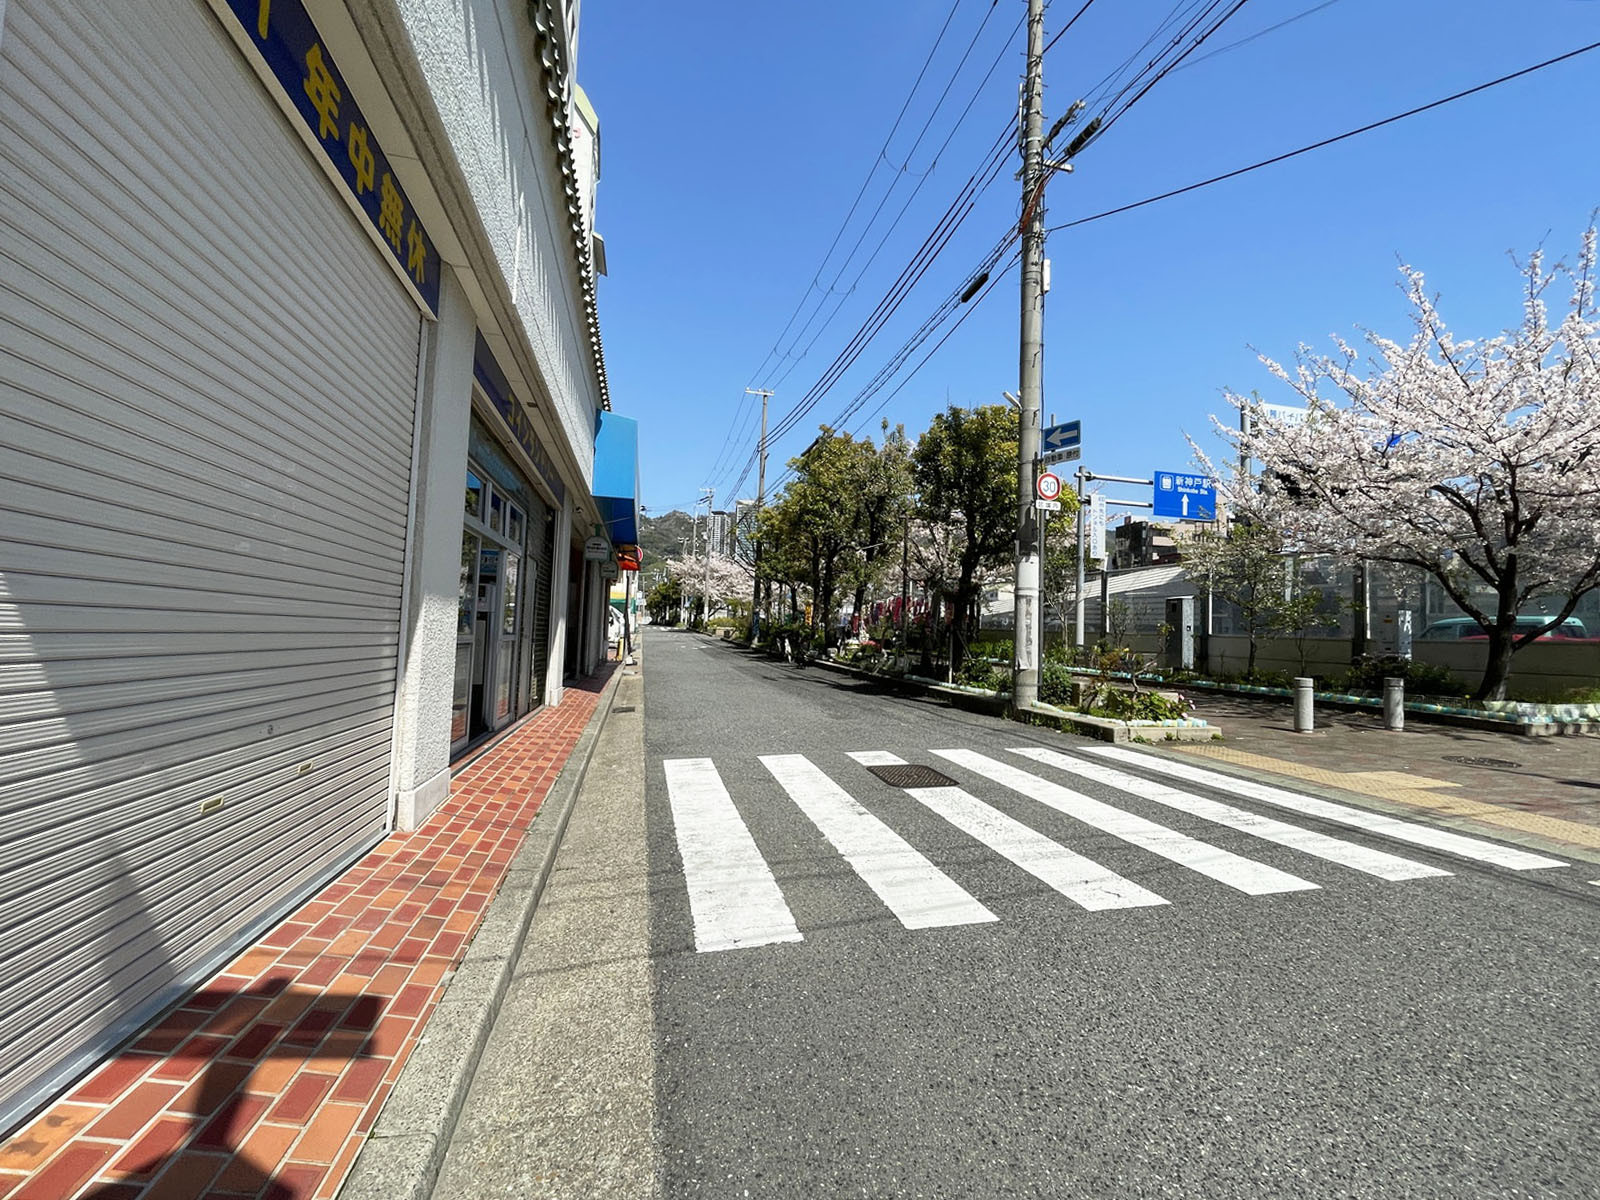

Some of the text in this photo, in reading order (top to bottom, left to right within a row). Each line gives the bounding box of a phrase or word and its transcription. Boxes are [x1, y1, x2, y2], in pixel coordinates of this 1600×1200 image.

[303, 43, 426, 284] 年中無休
[1042, 480, 1056, 493] 30
[1175, 475, 1213, 489] 新神戸駅
